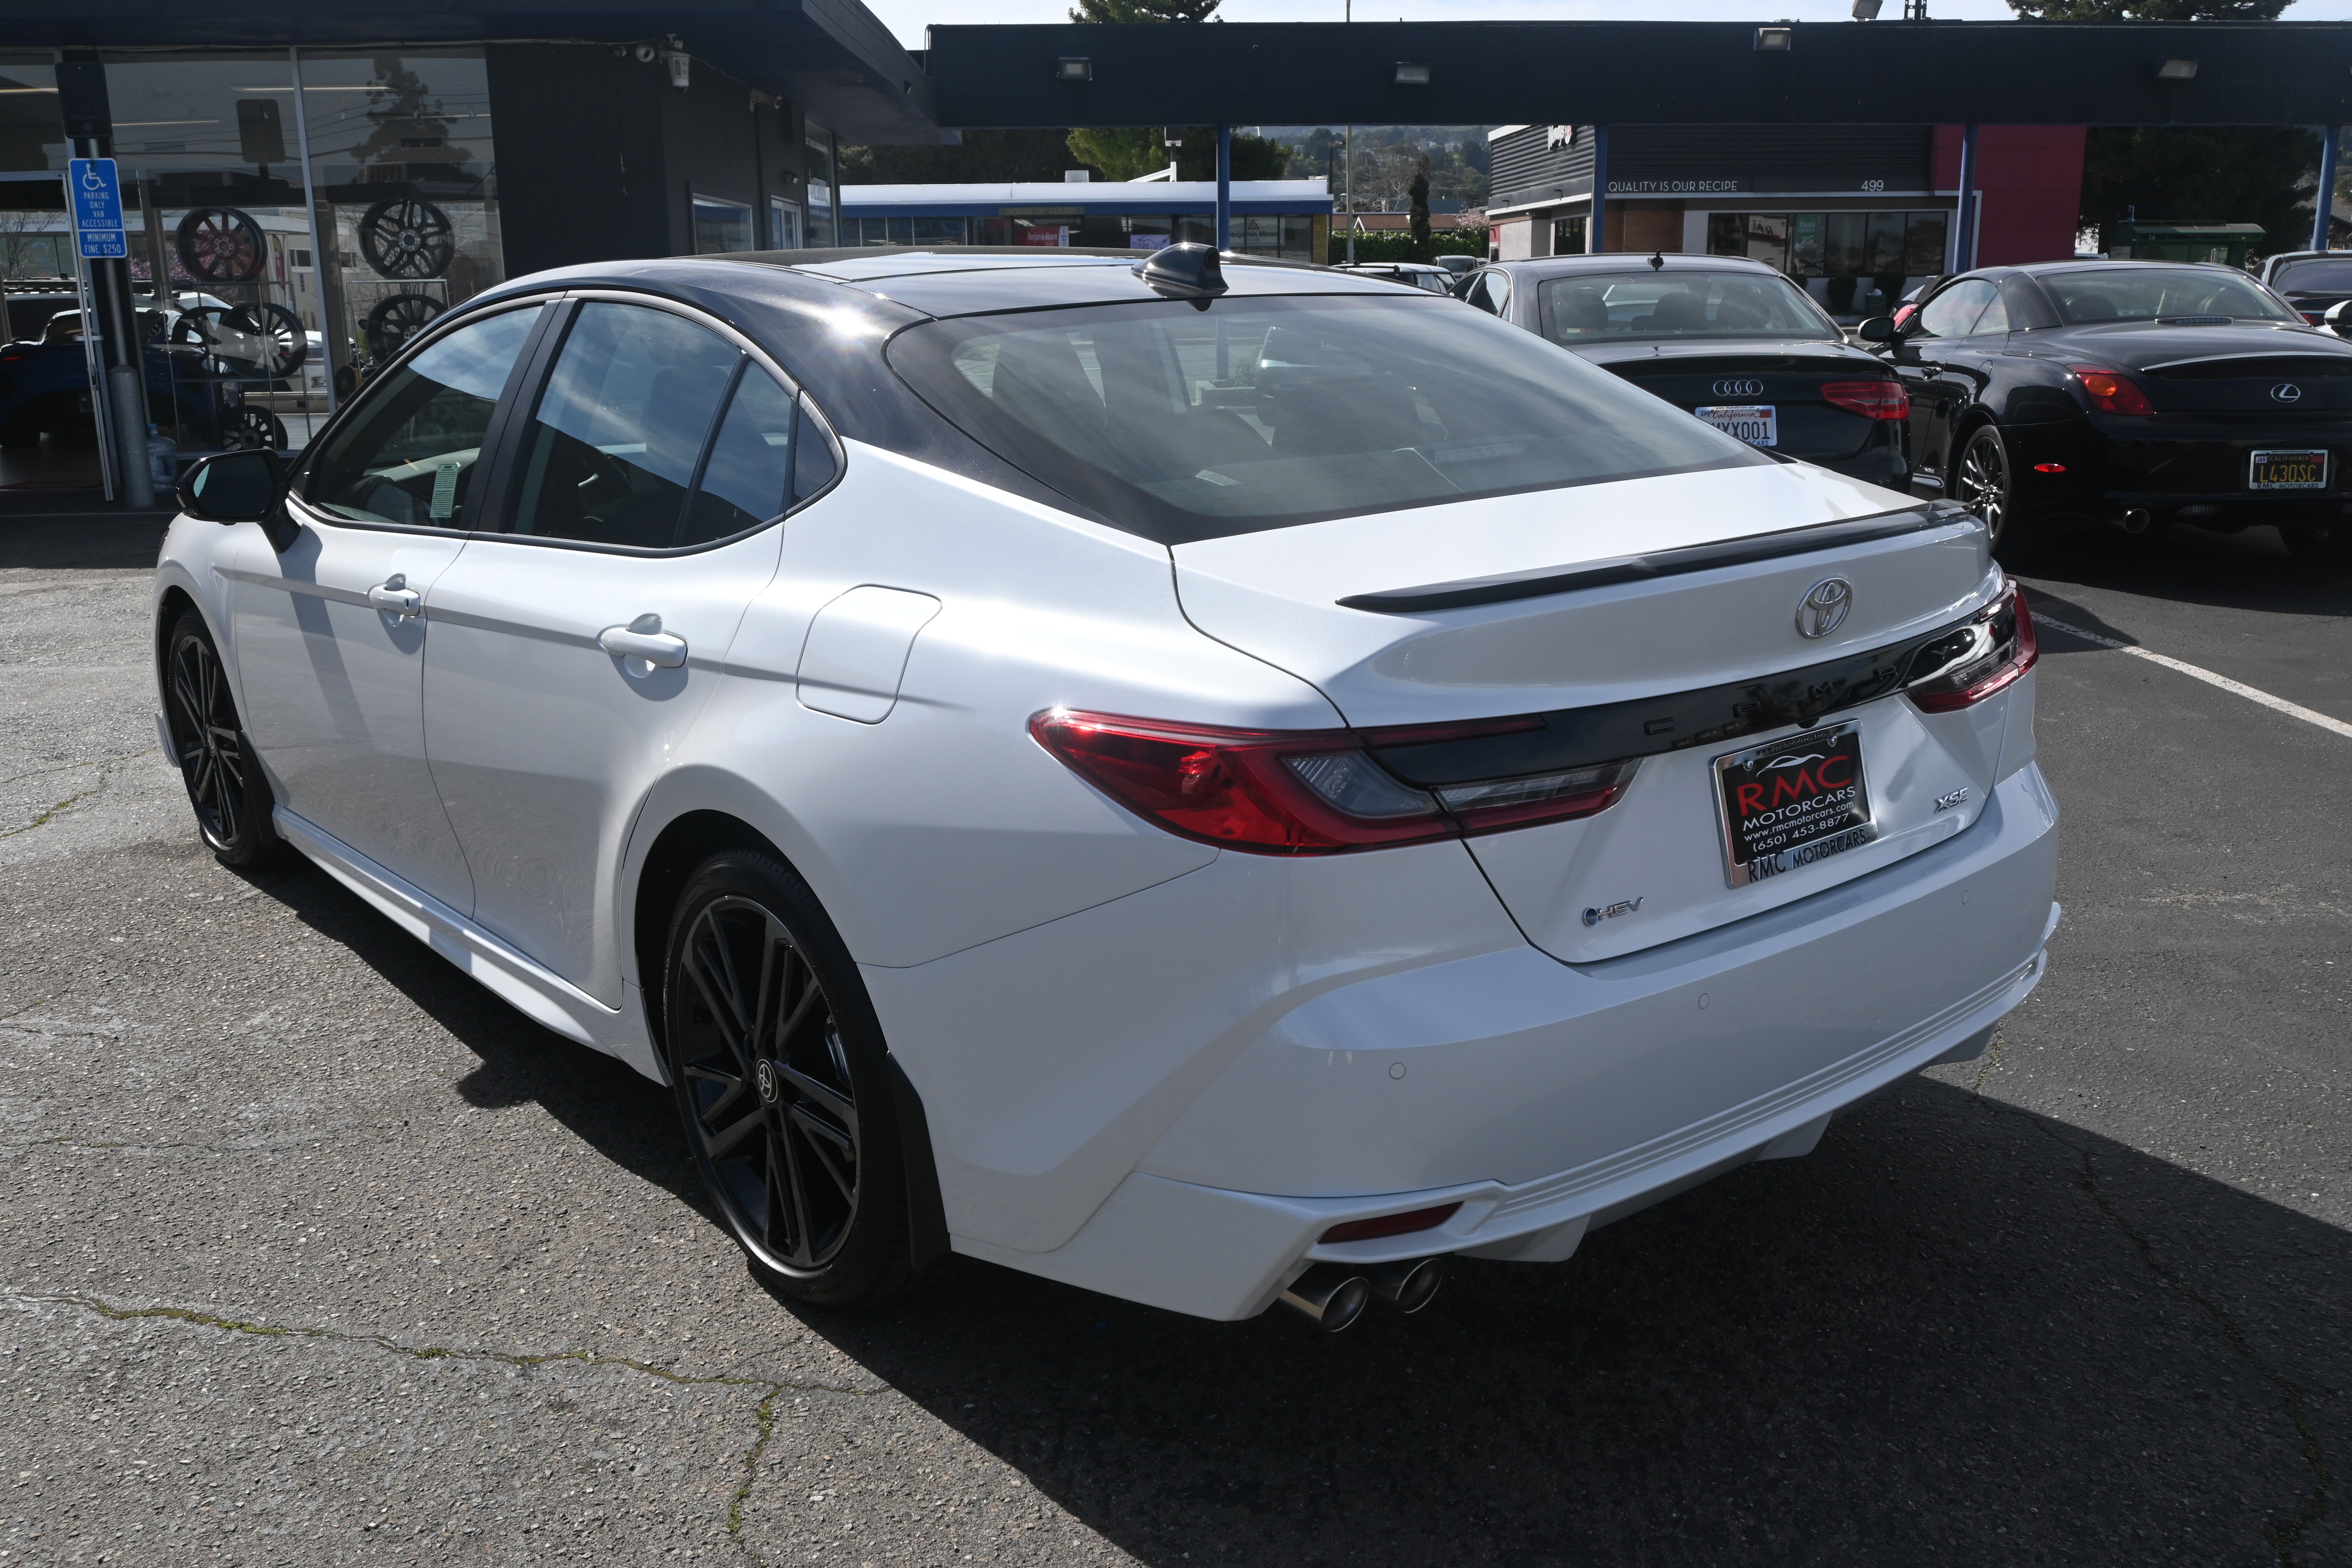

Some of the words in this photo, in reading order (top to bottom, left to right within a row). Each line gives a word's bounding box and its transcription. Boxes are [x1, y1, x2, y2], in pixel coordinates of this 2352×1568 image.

[1609, 181, 1657, 192] QUALITY
[1661, 181, 1669, 191] IS
[1672, 181, 1695, 191] OUR
[1699, 181, 1738, 191] RECIPE
[1861, 180, 1884, 191] 499
[82, 219, 118, 227] ACCESSIBLE
[87, 233, 116, 242] MINIMUM
[1230, 231, 1257, 239] enjamin
[84, 244, 99, 253] FINE
[103, 243, 121, 253] $250
[1712, 410, 1760, 421] California
[2260, 465, 2316, 482] L430SC
[1737, 755, 1852, 817] RMC
[1742, 786, 1856, 831] MOTORCARS
[1934, 787, 1968, 814] XSE
[1744, 800, 1854, 841] www.rmcmotorcars.com
[1753, 834, 1786, 852] (650)
[1792, 813, 1849, 838] 453-8877
[1747, 850, 1786, 883] RMC
[1792, 828, 1866, 868] MOTORCARS
[1597, 897, 1644, 921] HEV
